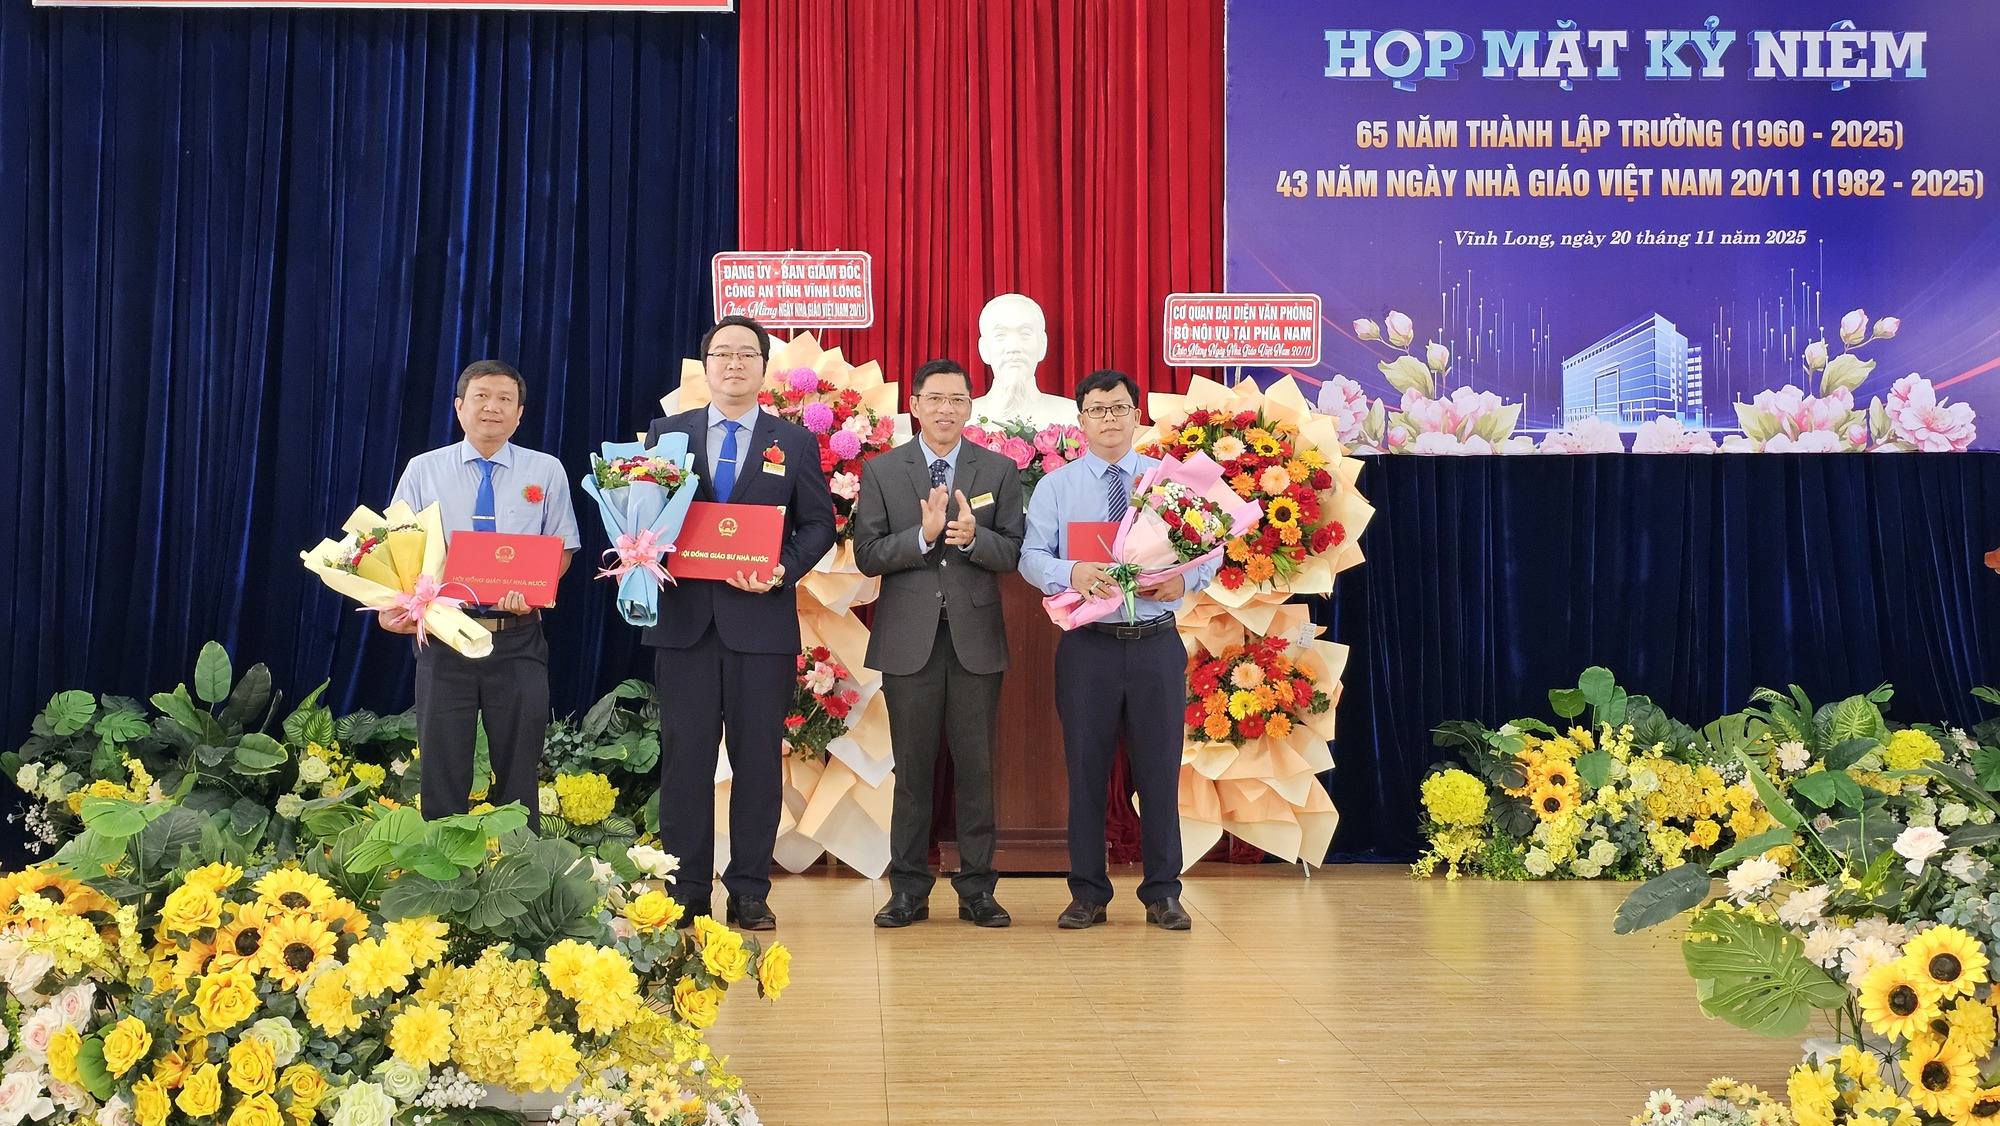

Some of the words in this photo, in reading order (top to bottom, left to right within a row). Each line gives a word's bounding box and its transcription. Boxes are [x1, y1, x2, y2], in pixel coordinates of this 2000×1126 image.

[1324, 30, 1470, 91] HỌP
[1482, 19, 1628, 91] MẶT
[1646, 15, 1736, 80] KỶ
[1750, 19, 1927, 91] NIỆM
[1356, 120, 1388, 148] 65
[1396, 114, 1458, 148] NĂM
[1466, 114, 1553, 148] THÀNH
[1561, 114, 1610, 153] LẬP
[1618, 113, 1722, 147] TRƯỜNG
[1732, 120, 1805, 150] (1960
[1812, 131, 1823, 139] -
[1830, 120, 1904, 150] 2025)
[1276, 170, 1308, 197] 43
[1316, 163, 1378, 197] NĂM
[1386, 163, 1457, 197] NGÀY
[1465, 164, 1520, 197] NHÀ
[1528, 163, 1590, 197] GIÁO
[1598, 163, 1653, 202] VIỆT
[1661, 168, 1722, 196] NAM
[1731, 168, 1800, 197] 20/11
[1812, 169, 1885, 199] (1982
[1893, 180, 1903, 188] -
[1911, 169, 1984, 199] 2025)
[1454, 230, 1498, 246] Vĩnh
[1503, 230, 1555, 249] Long,
[1559, 231, 1606, 249] ngày
[1609, 230, 1632, 246] 20
[1636, 230, 1691, 248] tháng
[1694, 230, 1714, 246] 11
[1719, 230, 1761, 246] năm
[1764, 230, 1807, 246] 2025
[723, 261, 755, 280] ĐẢNG
[757, 261, 772, 280] ỦY
[781, 264, 805, 280] BAN
[807, 263, 837, 280] GIÁM
[839, 261, 861, 280] ĐỐC
[724, 283, 755, 298] CÔNG
[758, 285, 774, 298] AN
[776, 282, 801, 298] TỈNH
[804, 283, 830, 298] VĨNH
[832, 285, 862, 298] LONG
[723, 301, 746, 316] Chúc
[747, 302, 778, 319] Mừng
[778, 302, 794, 317] NGÀY
[795, 301, 807, 317] NHÀ
[807, 302, 821, 317] GIÁO
[834, 303, 848, 317] NAM
[849, 303, 865, 317] 20/11
[1173, 305, 1187, 321] CƠ
[1188, 305, 1214, 322] QUAN
[1215, 305, 1231, 324] ĐẠI
[1233, 303, 1256, 324] DIỆN
[1258, 303, 1278, 321] VĂN
[1280, 303, 1312, 321] PHÒNG
[1174, 323, 1189, 344] BỘ
[1192, 323, 1212, 344] NỘI
[1215, 325, 1230, 344] VỤ
[1233, 325, 1250, 344] TẠI
[1253, 323, 1281, 341] PHÍA
[1284, 326, 1311, 341] NAM
[1172, 343, 1187, 357] Chúc
[1274, 343, 1290, 357] Nam
[1291, 345, 1312, 357] 20/11
[709, 551, 726, 560] GIÁO
